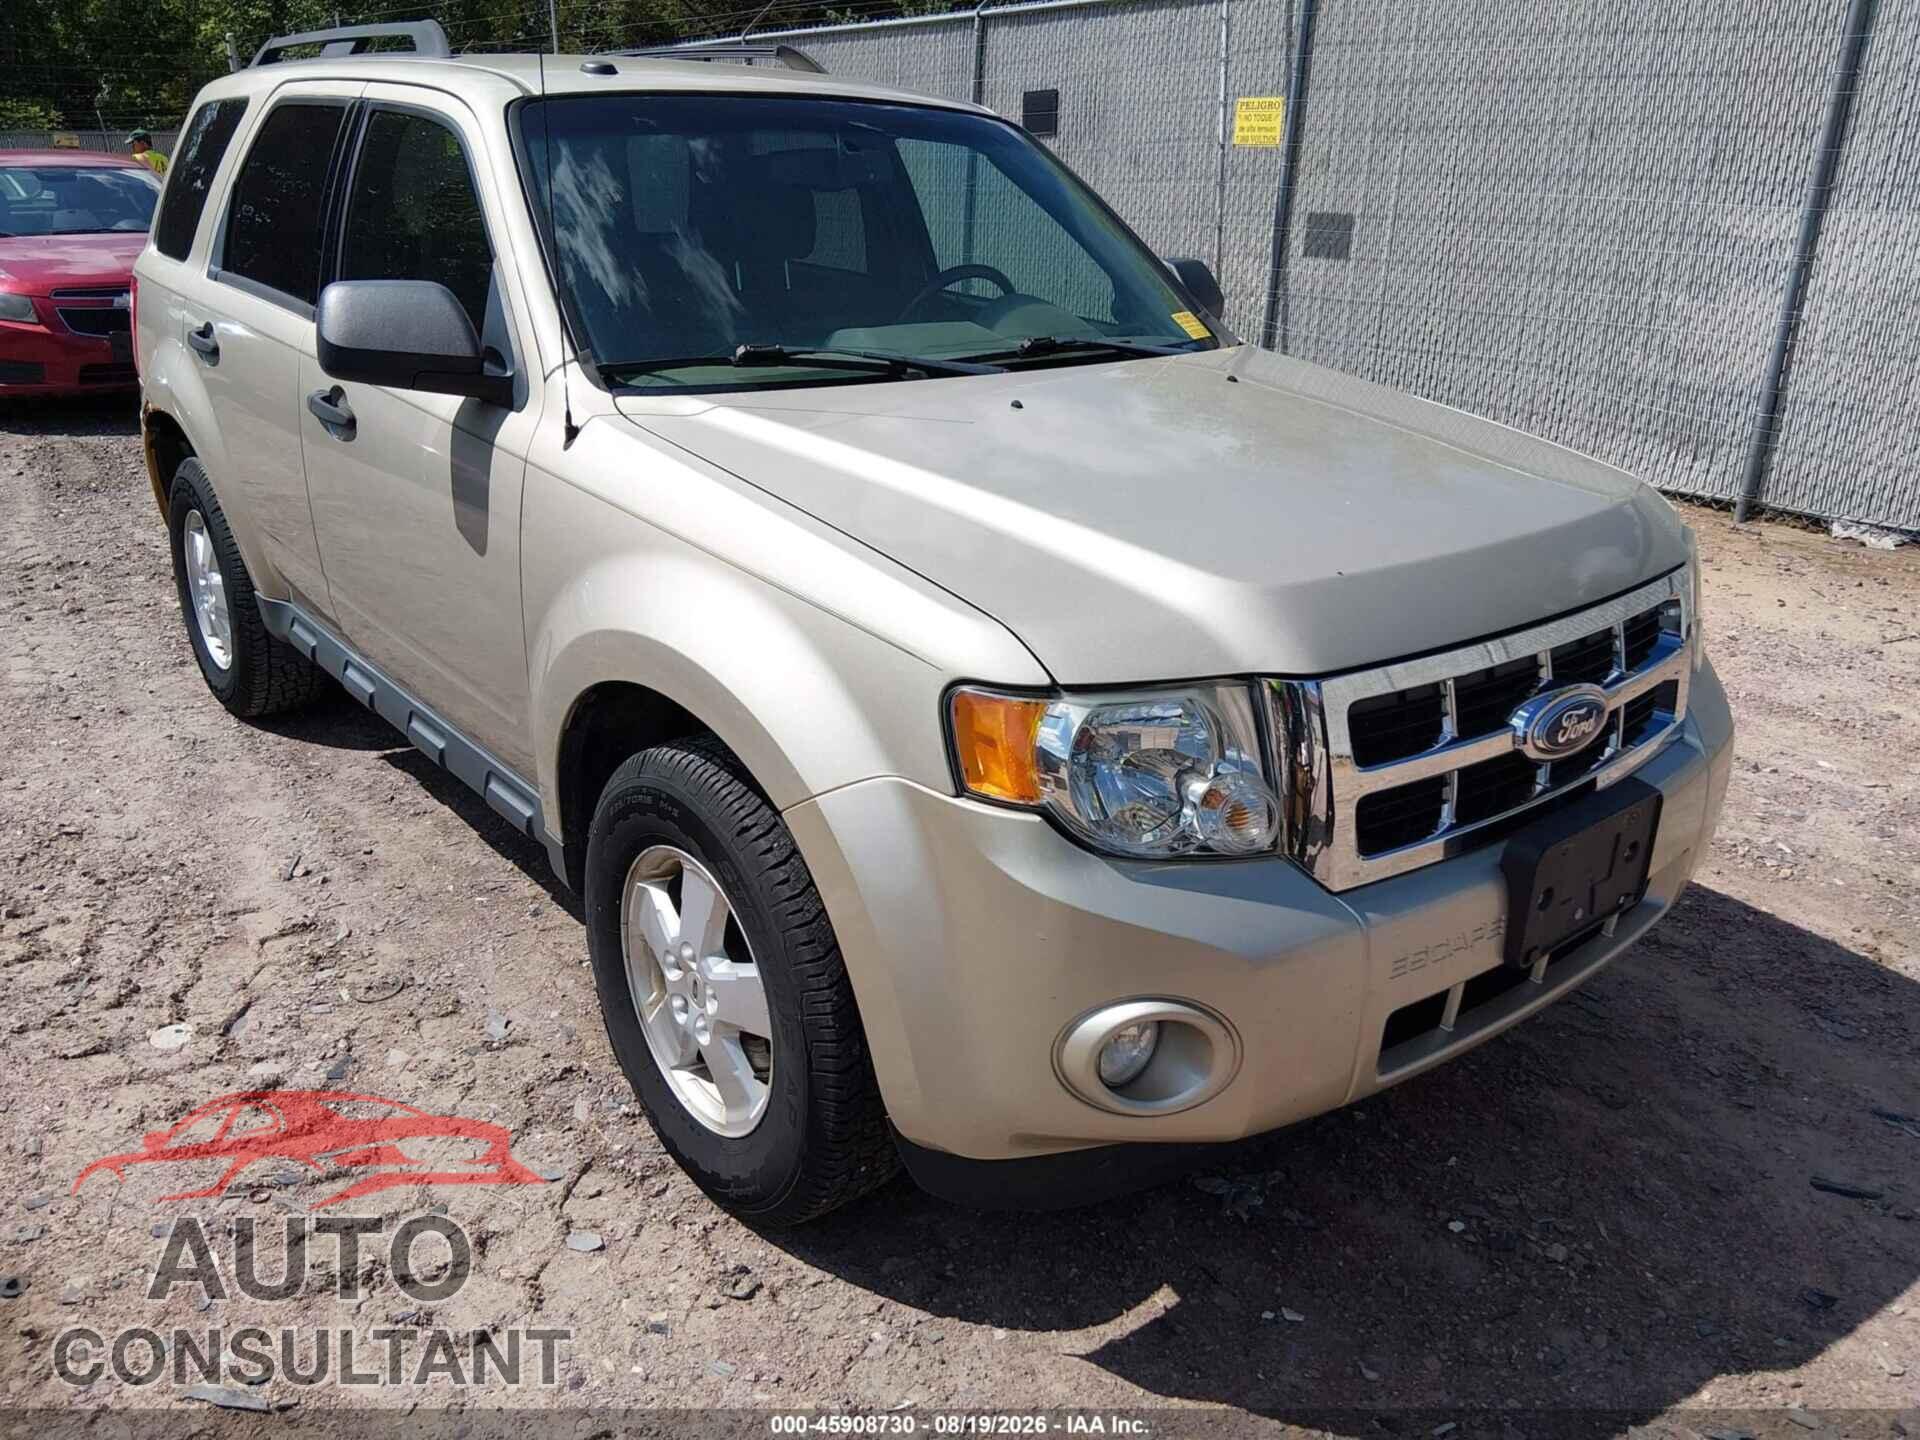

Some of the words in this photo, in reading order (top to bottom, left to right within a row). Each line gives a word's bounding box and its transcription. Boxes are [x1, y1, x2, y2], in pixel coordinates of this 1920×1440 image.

[1239, 100, 1281, 111] PELIGRO
[1253, 113, 1273, 122] TOQUE
[1558, 706, 1597, 743] Ford
[1388, 916, 1504, 981] ESCAPE
